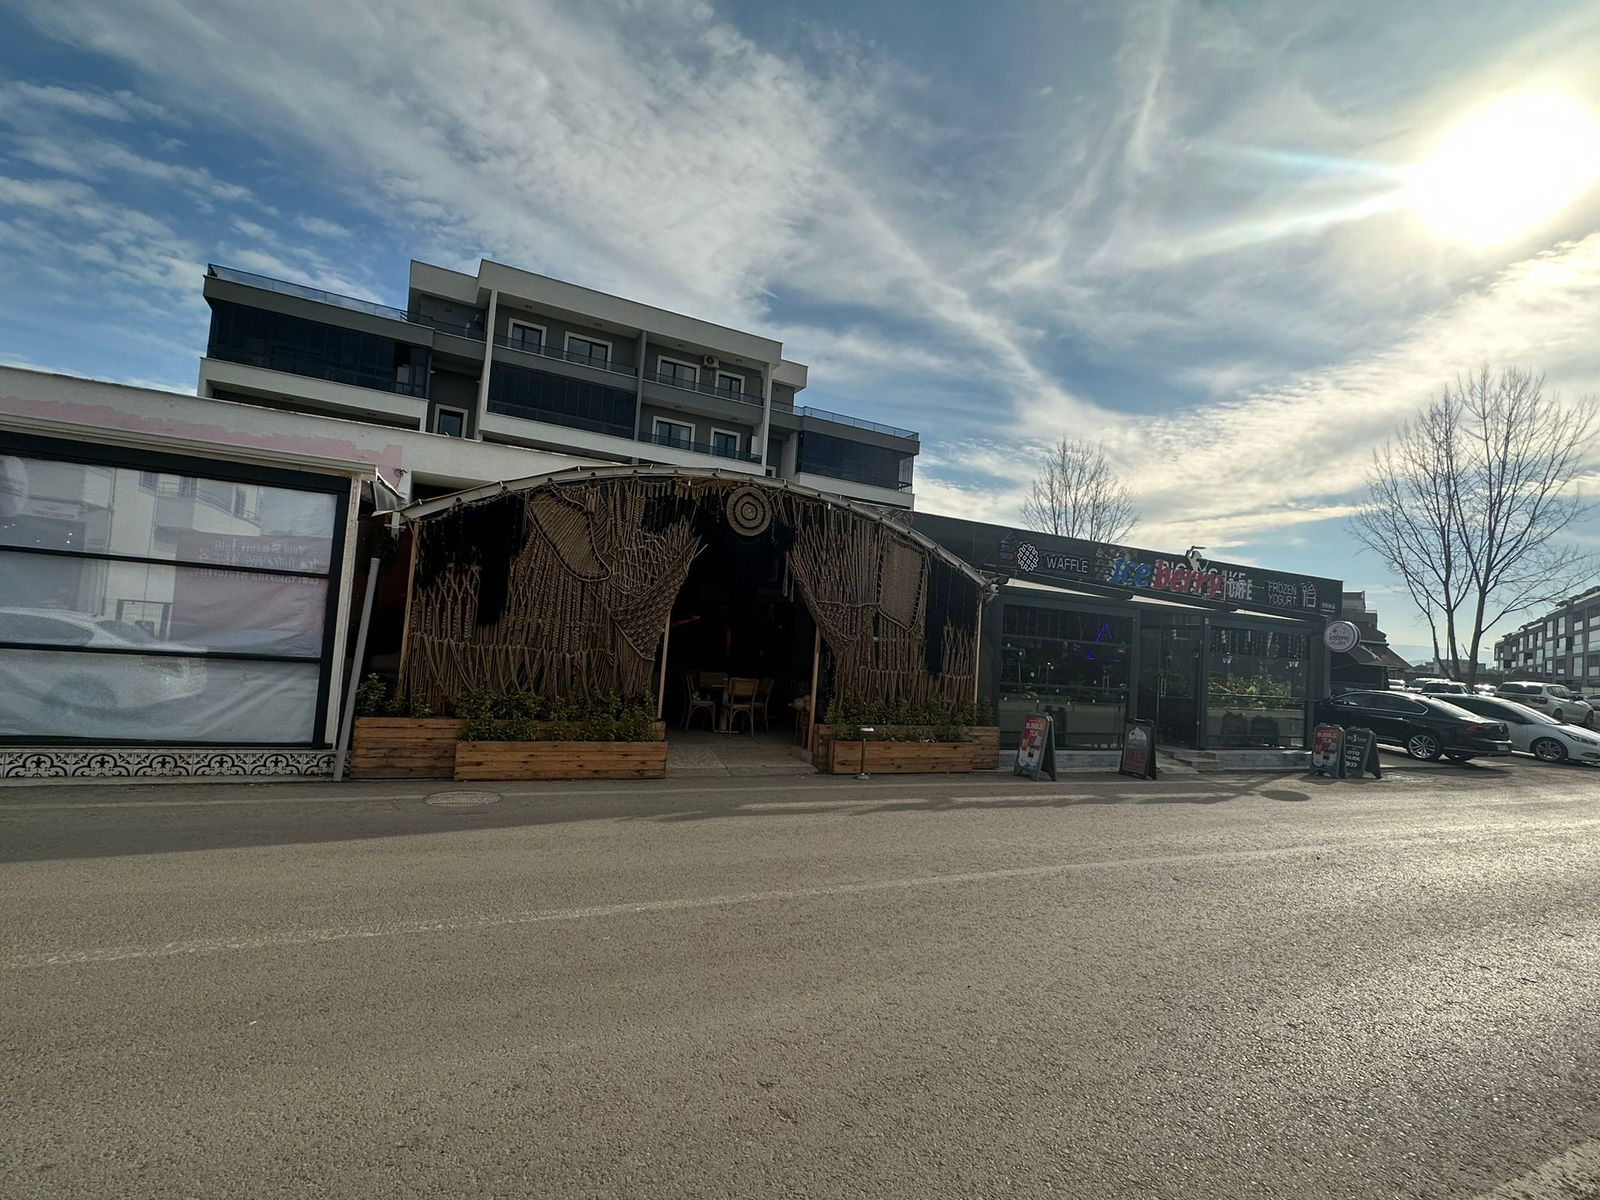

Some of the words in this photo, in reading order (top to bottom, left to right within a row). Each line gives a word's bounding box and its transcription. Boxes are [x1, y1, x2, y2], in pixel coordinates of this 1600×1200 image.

[1046, 555, 1088, 574] WAFFLE
[1106, 551, 1152, 588] ice
[1151, 559, 1225, 601] berry
[1267, 581, 1297, 595] FROZEN
[1267, 592, 1297, 607] YOGURT
